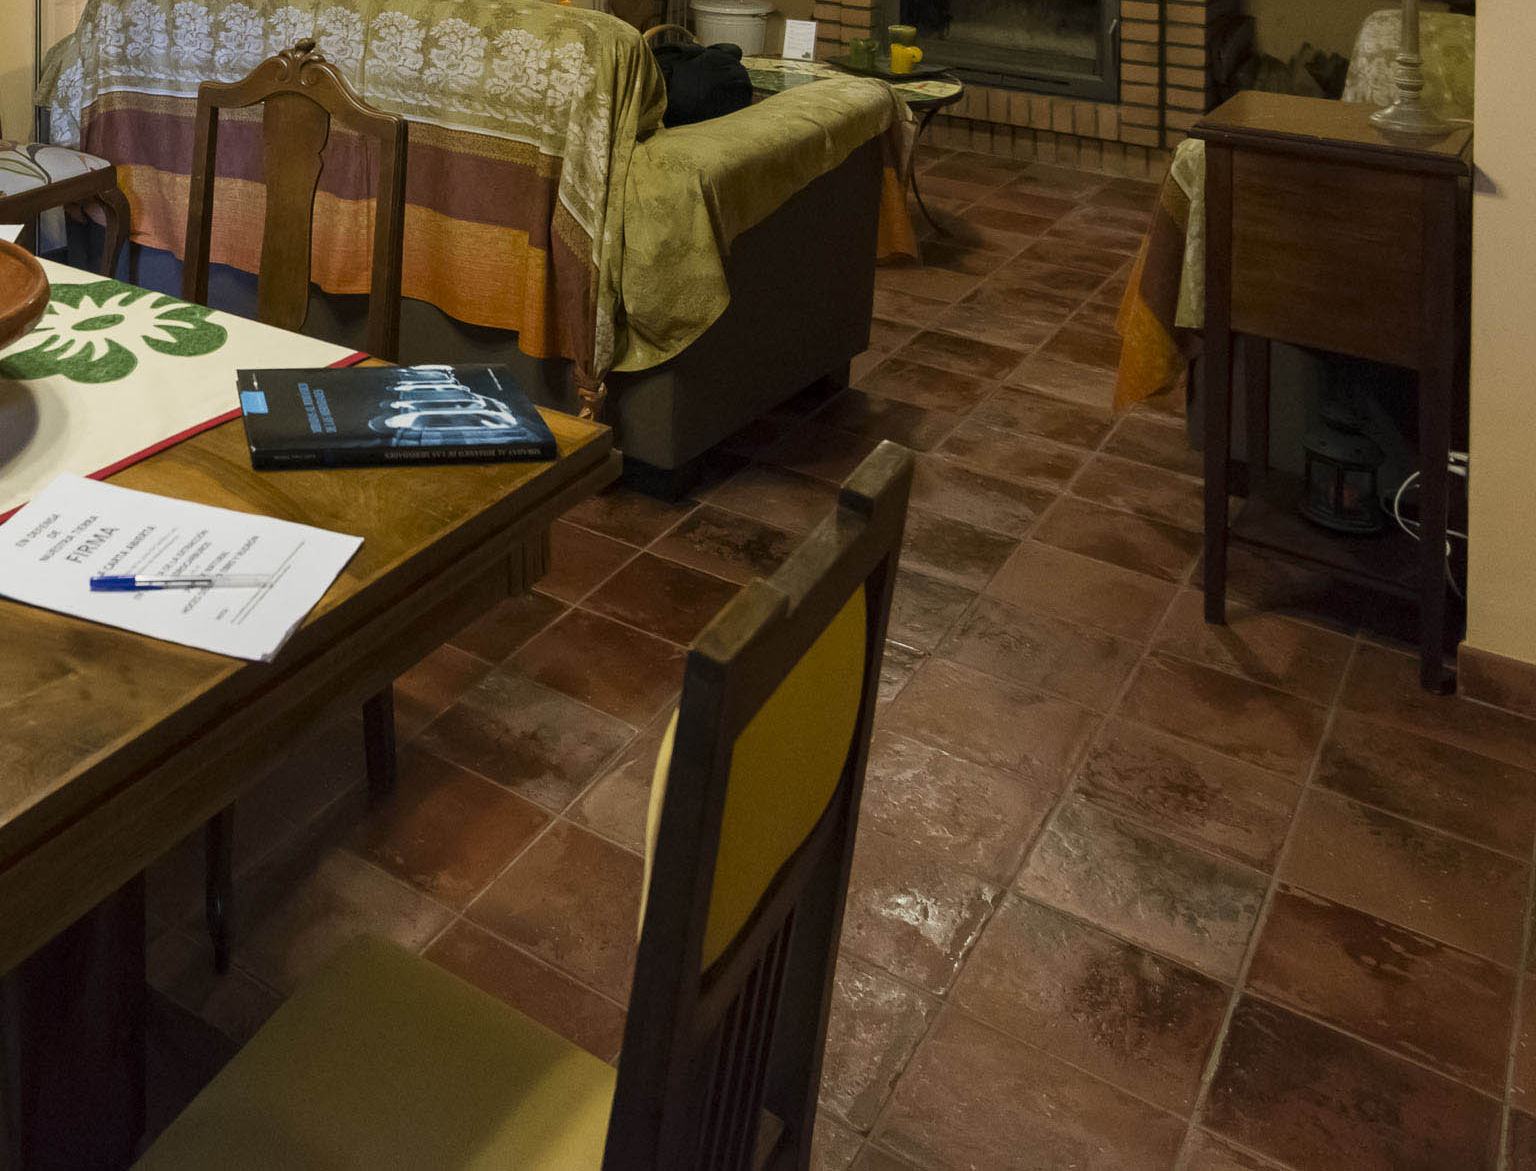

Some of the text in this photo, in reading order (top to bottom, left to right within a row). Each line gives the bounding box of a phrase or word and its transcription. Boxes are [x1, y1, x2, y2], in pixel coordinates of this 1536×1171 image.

[14, 513, 61, 547] EN DEFENSA
[38, 515, 99, 561] NUESTRA TIERRA
[45, 530, 61, 538] DE
[65, 525, 119, 563] FIRMA
[101, 550, 130, 570] CARTA
[125, 525, 157, 549] ABIERTA
